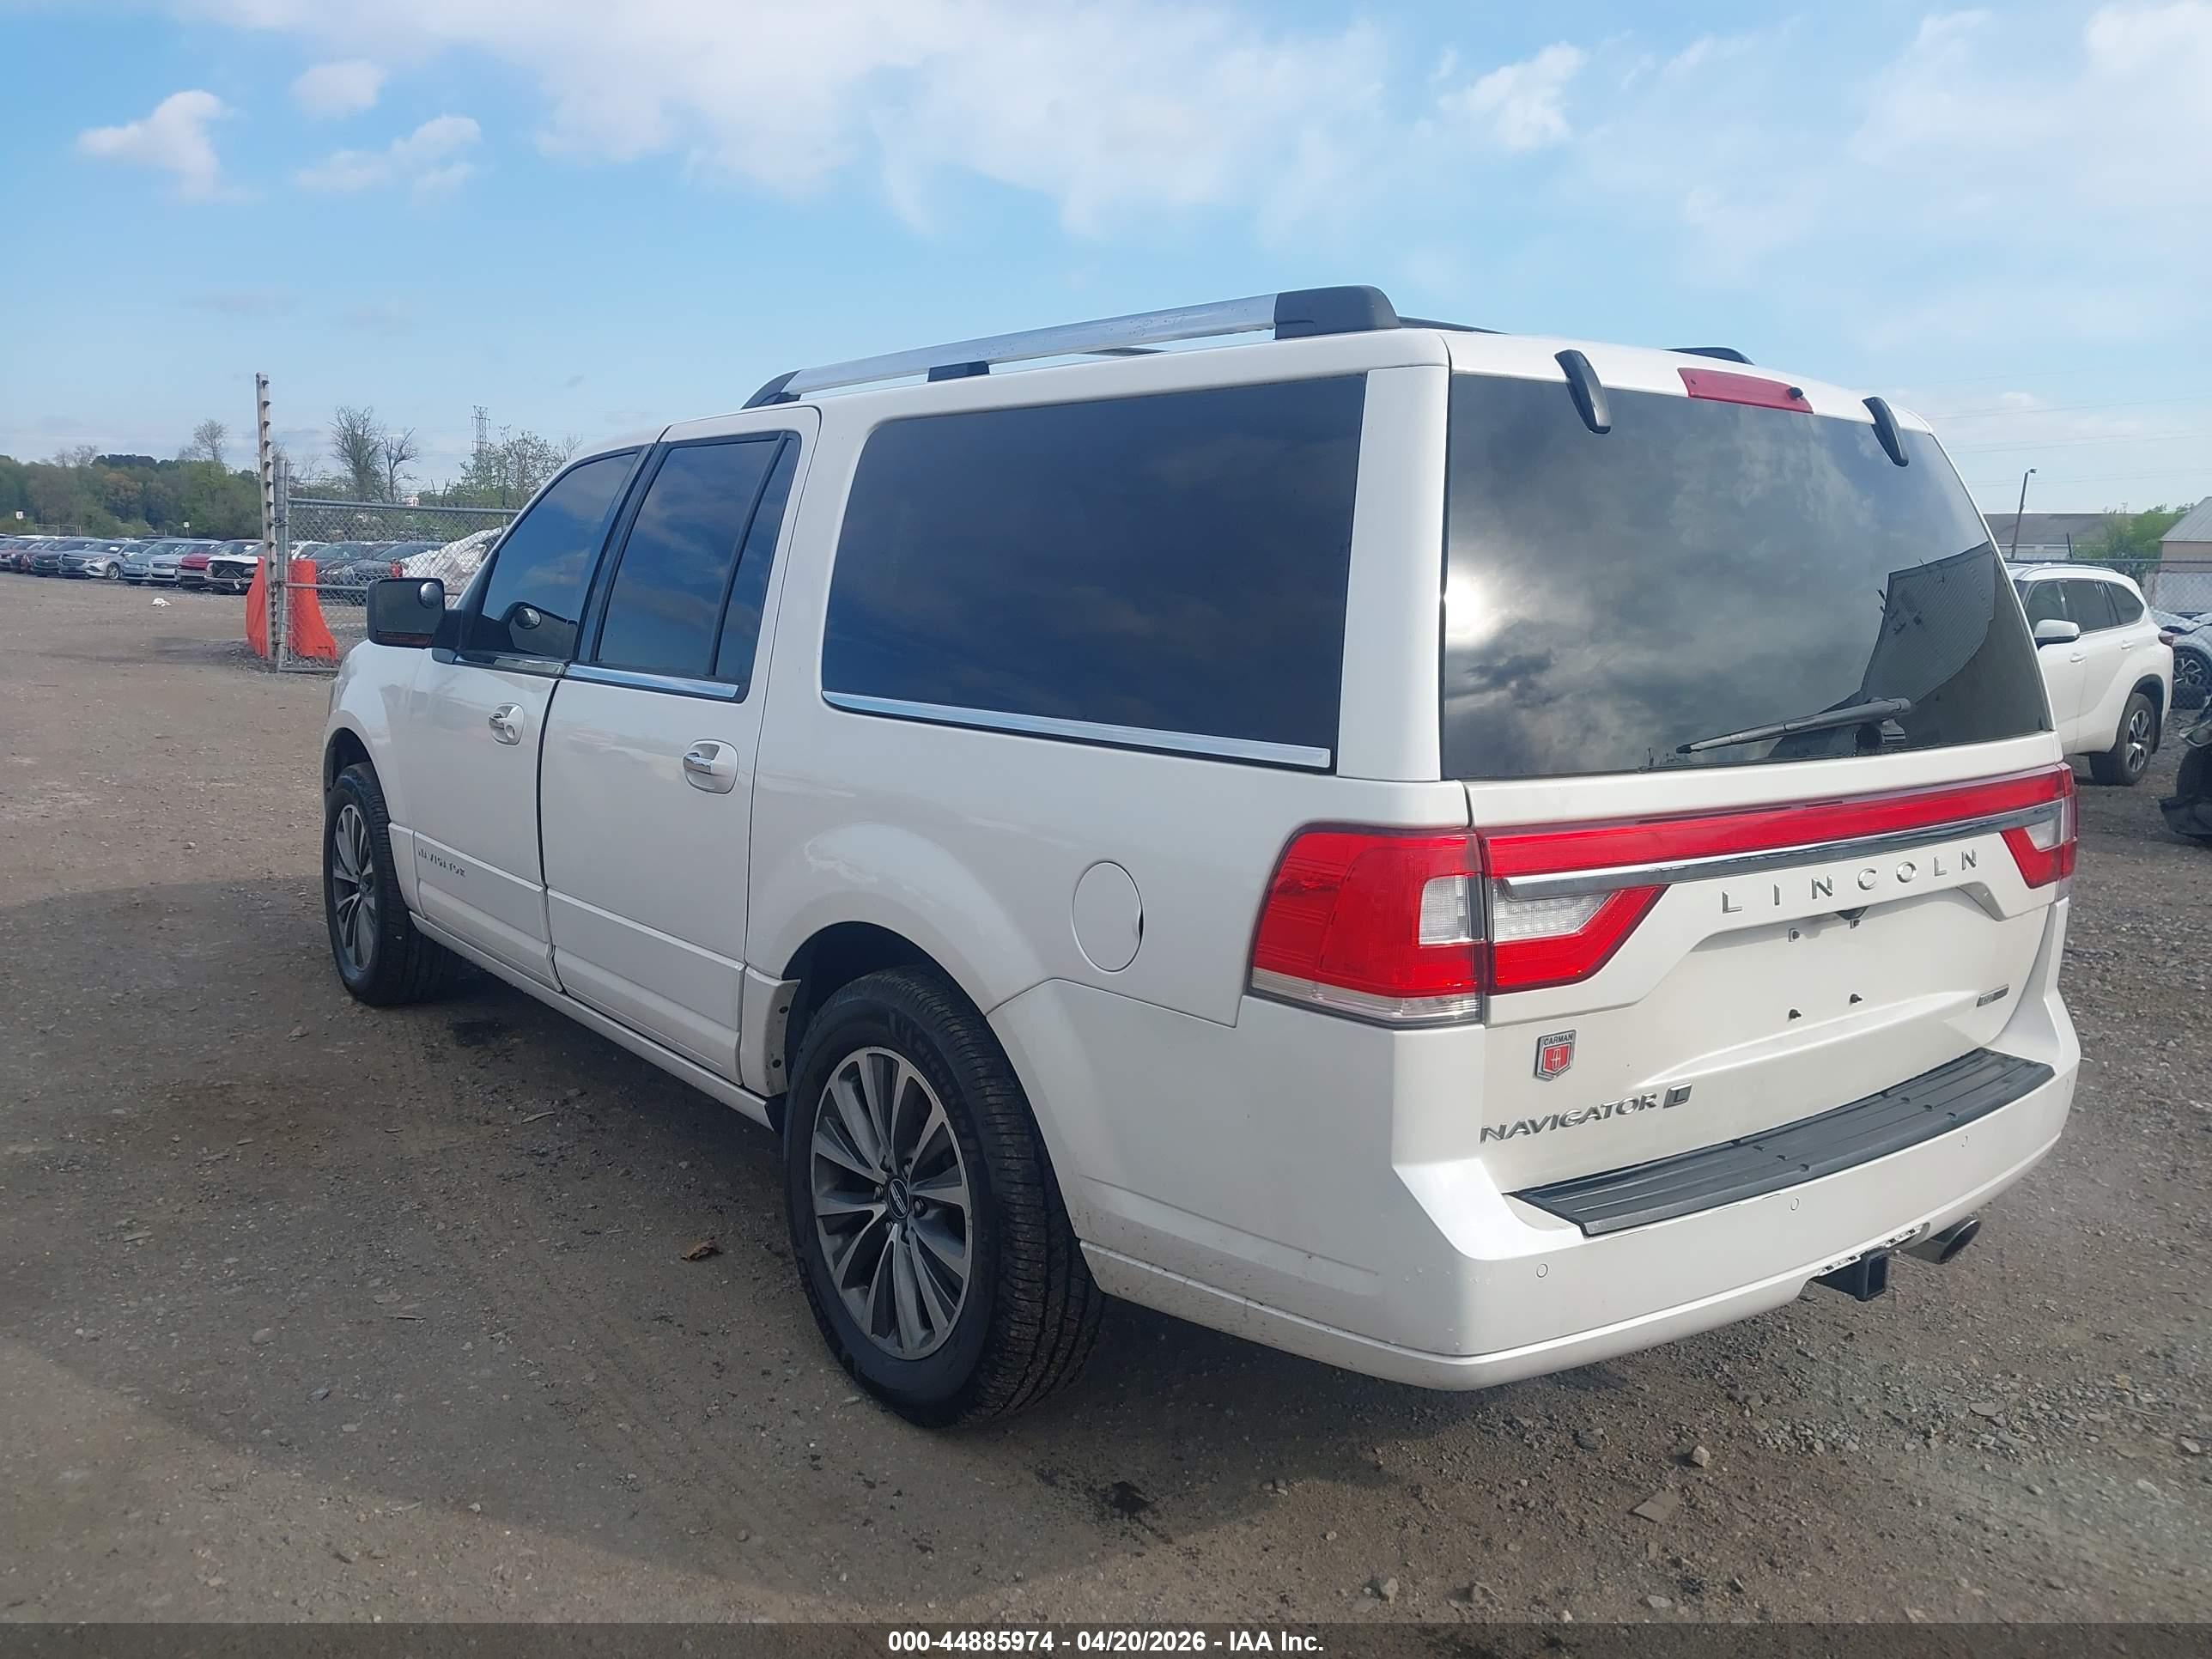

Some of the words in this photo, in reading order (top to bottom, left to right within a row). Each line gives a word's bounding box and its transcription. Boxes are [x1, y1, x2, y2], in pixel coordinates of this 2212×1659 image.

[1722, 849, 1977, 914] LINCOLN
[1543, 1032, 1574, 1046] CARMAN
[1480, 1092, 1656, 1144] NAVIGATOR
